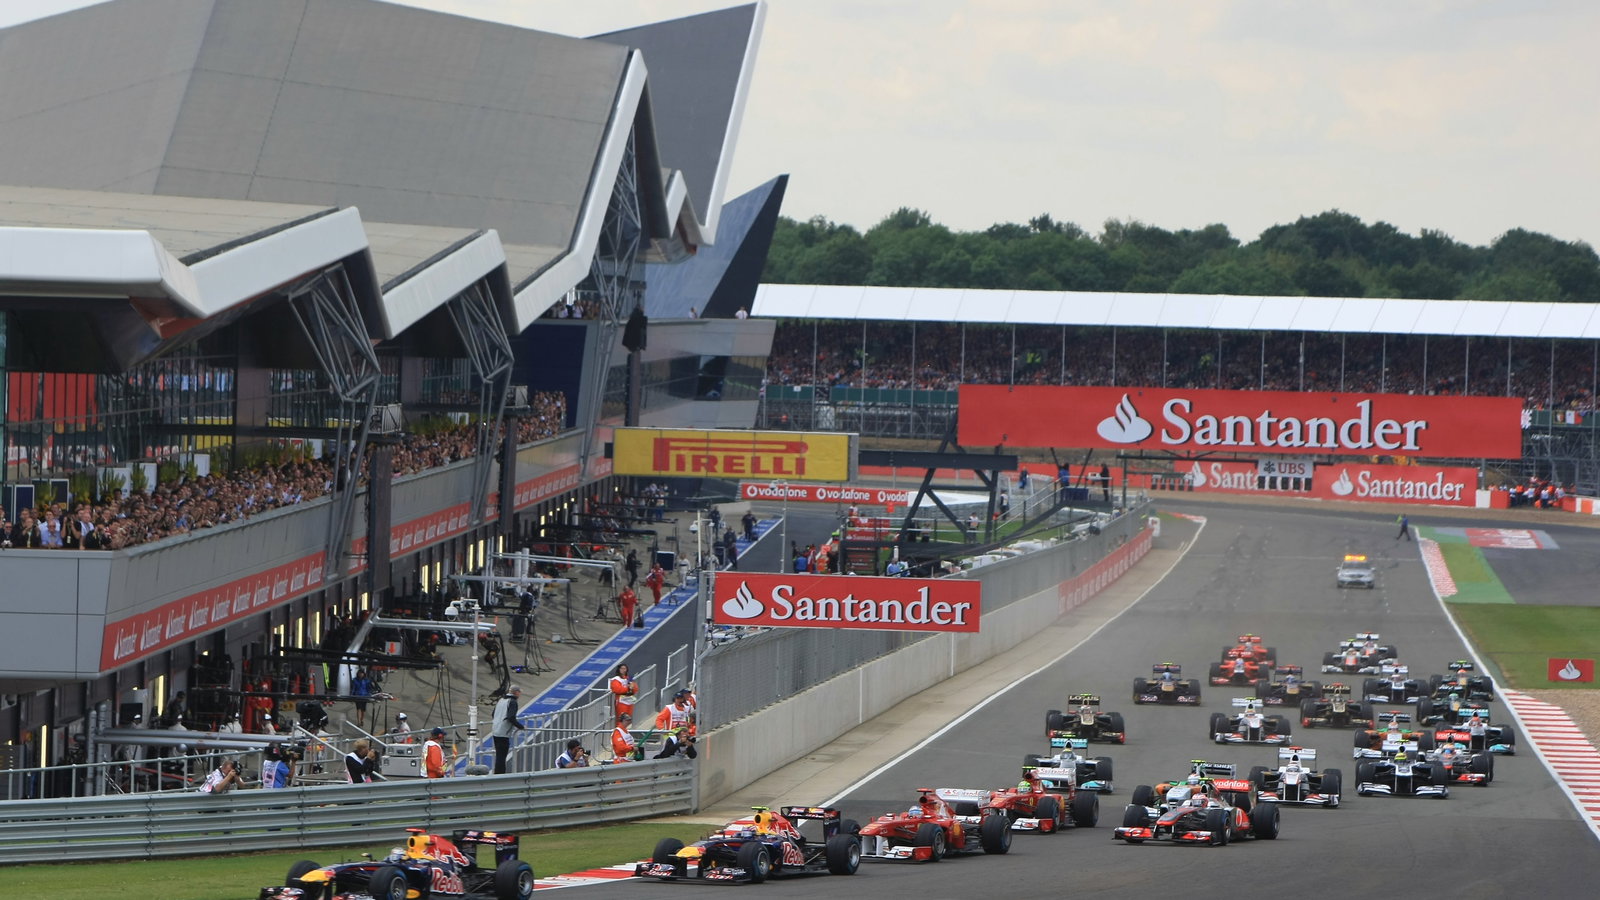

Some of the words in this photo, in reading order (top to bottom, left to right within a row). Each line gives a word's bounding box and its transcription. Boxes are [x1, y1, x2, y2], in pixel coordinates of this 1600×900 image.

[1161, 398, 1427, 451] Santander
[652, 437, 809, 475] PIRELLI
[1278, 463, 1306, 475] UBS
[1357, 470, 1465, 501] Santander
[770, 585, 971, 626] Santander
